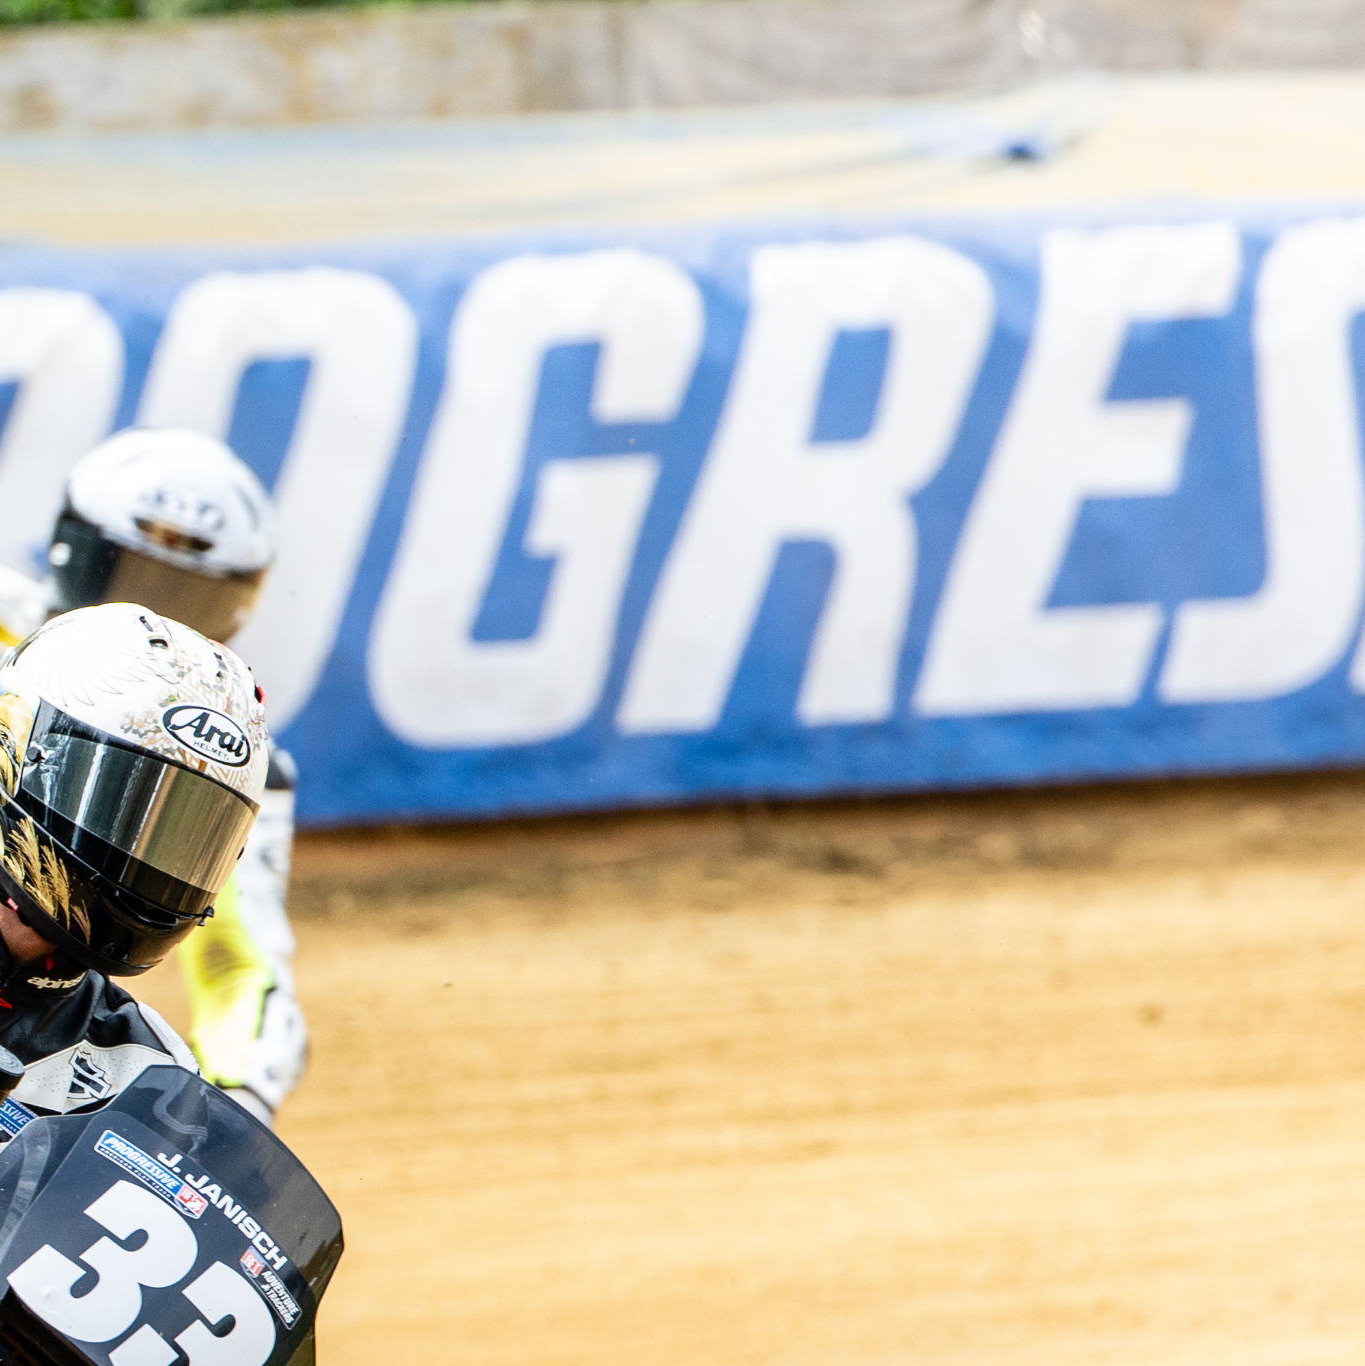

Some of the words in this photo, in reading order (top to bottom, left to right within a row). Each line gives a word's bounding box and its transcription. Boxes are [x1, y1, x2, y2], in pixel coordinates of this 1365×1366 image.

[170, 711, 248, 758] Arai
[103, 1136, 181, 1190] PROGRESSIVE
[157, 1152, 183, 1174] J.
[185, 1173, 288, 1270] JANISCH
[261, 1270, 299, 1315] ADVENTURE
